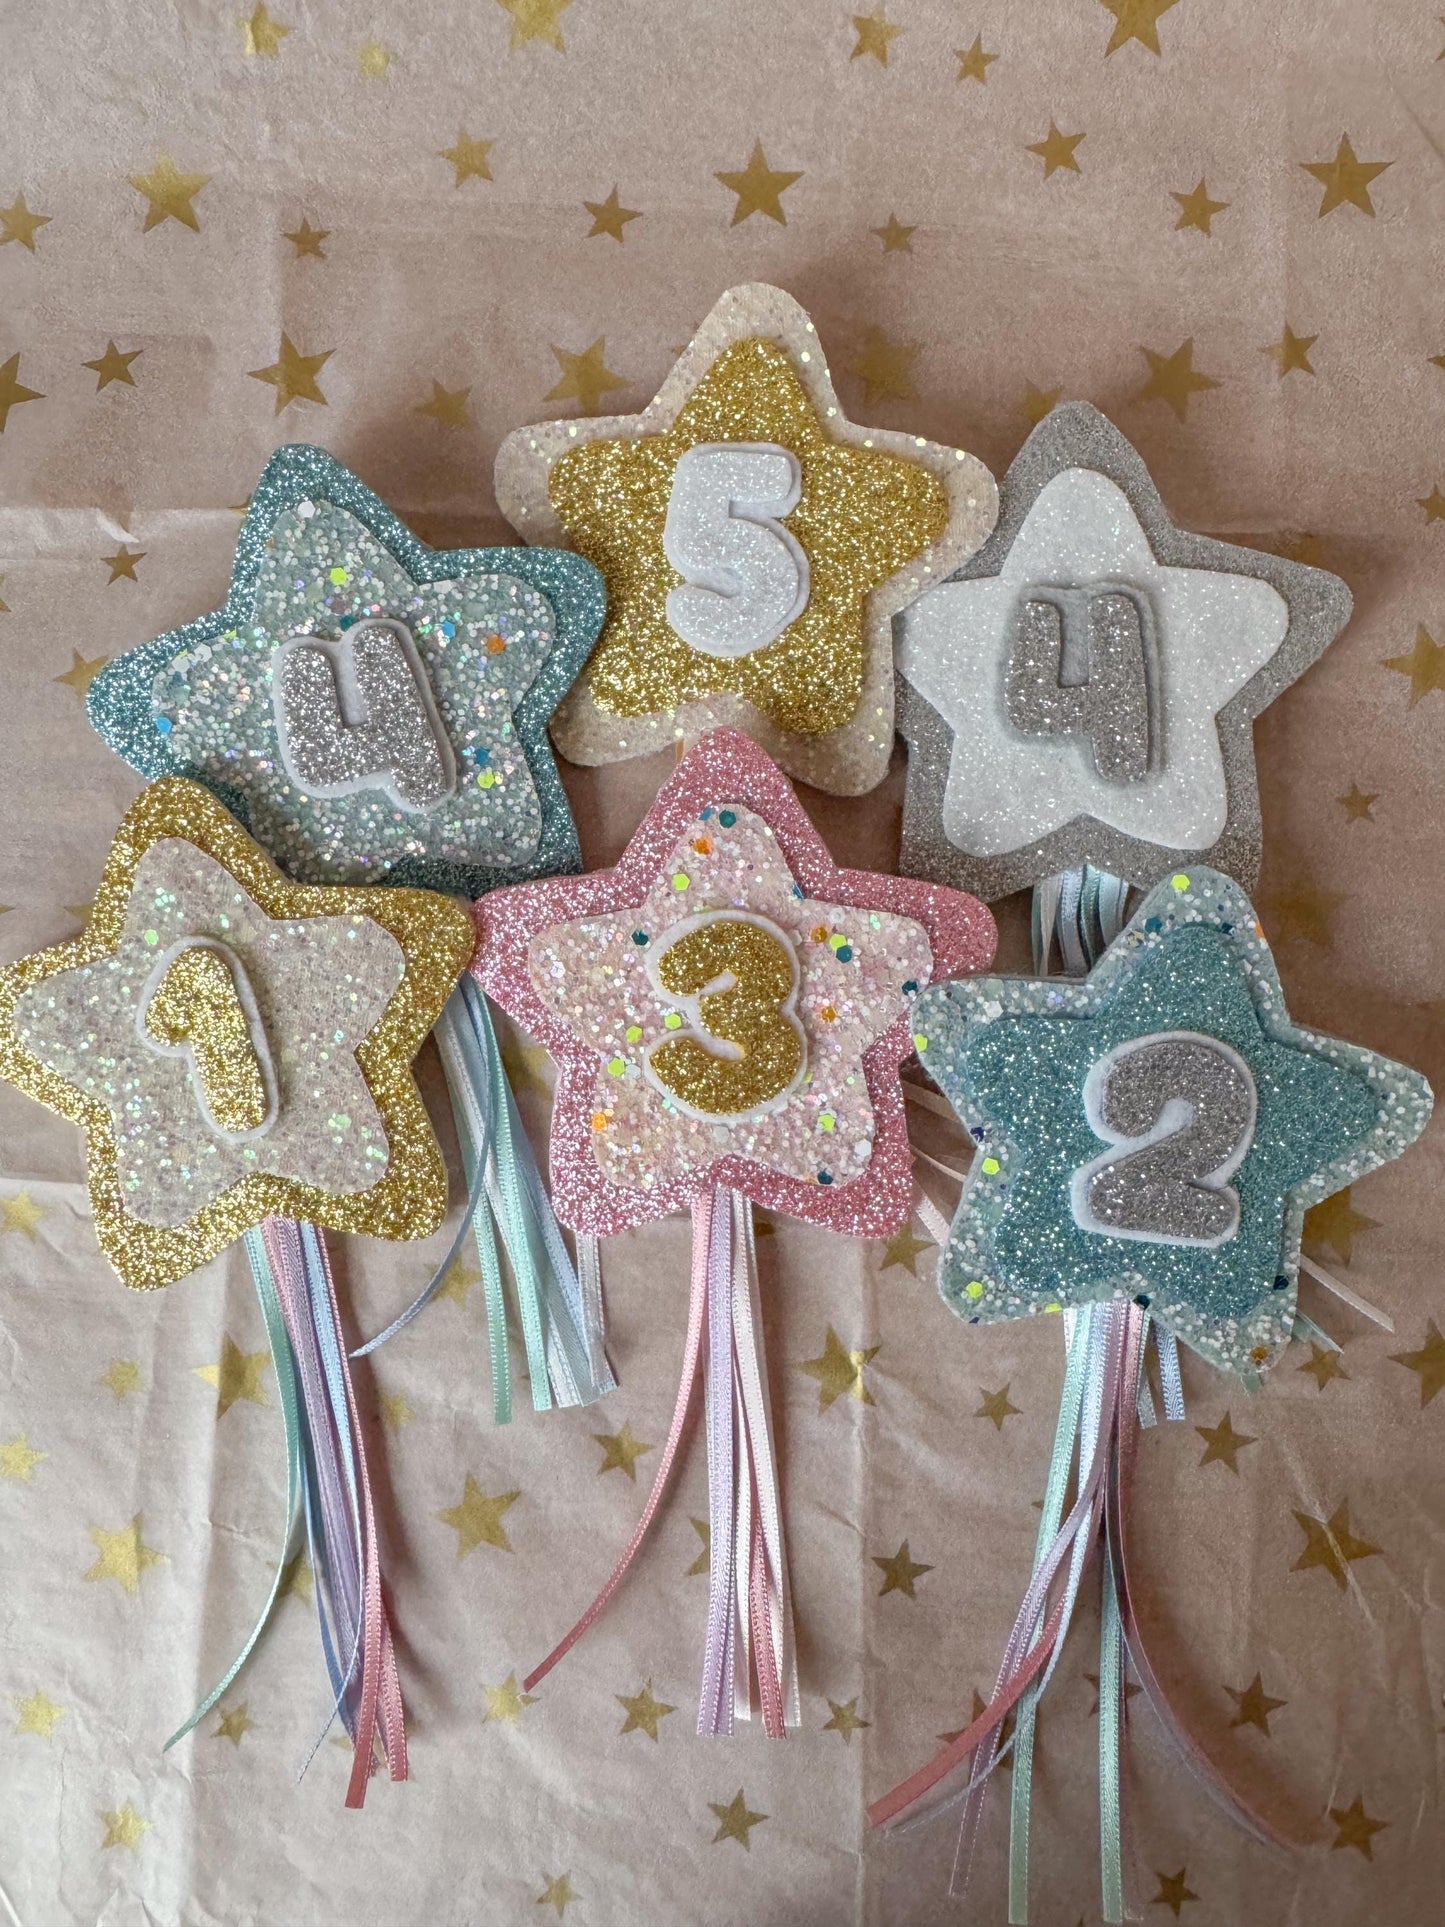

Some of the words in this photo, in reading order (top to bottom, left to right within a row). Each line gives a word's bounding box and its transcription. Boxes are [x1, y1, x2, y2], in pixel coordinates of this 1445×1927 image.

[665, 446, 806, 654] 5
[279, 624, 451, 810] 4
[1004, 592, 1150, 783] 4
[143, 945, 269, 1134] 1
[647, 917, 803, 1117] 3
[1086, 1038, 1252, 1241] 2
